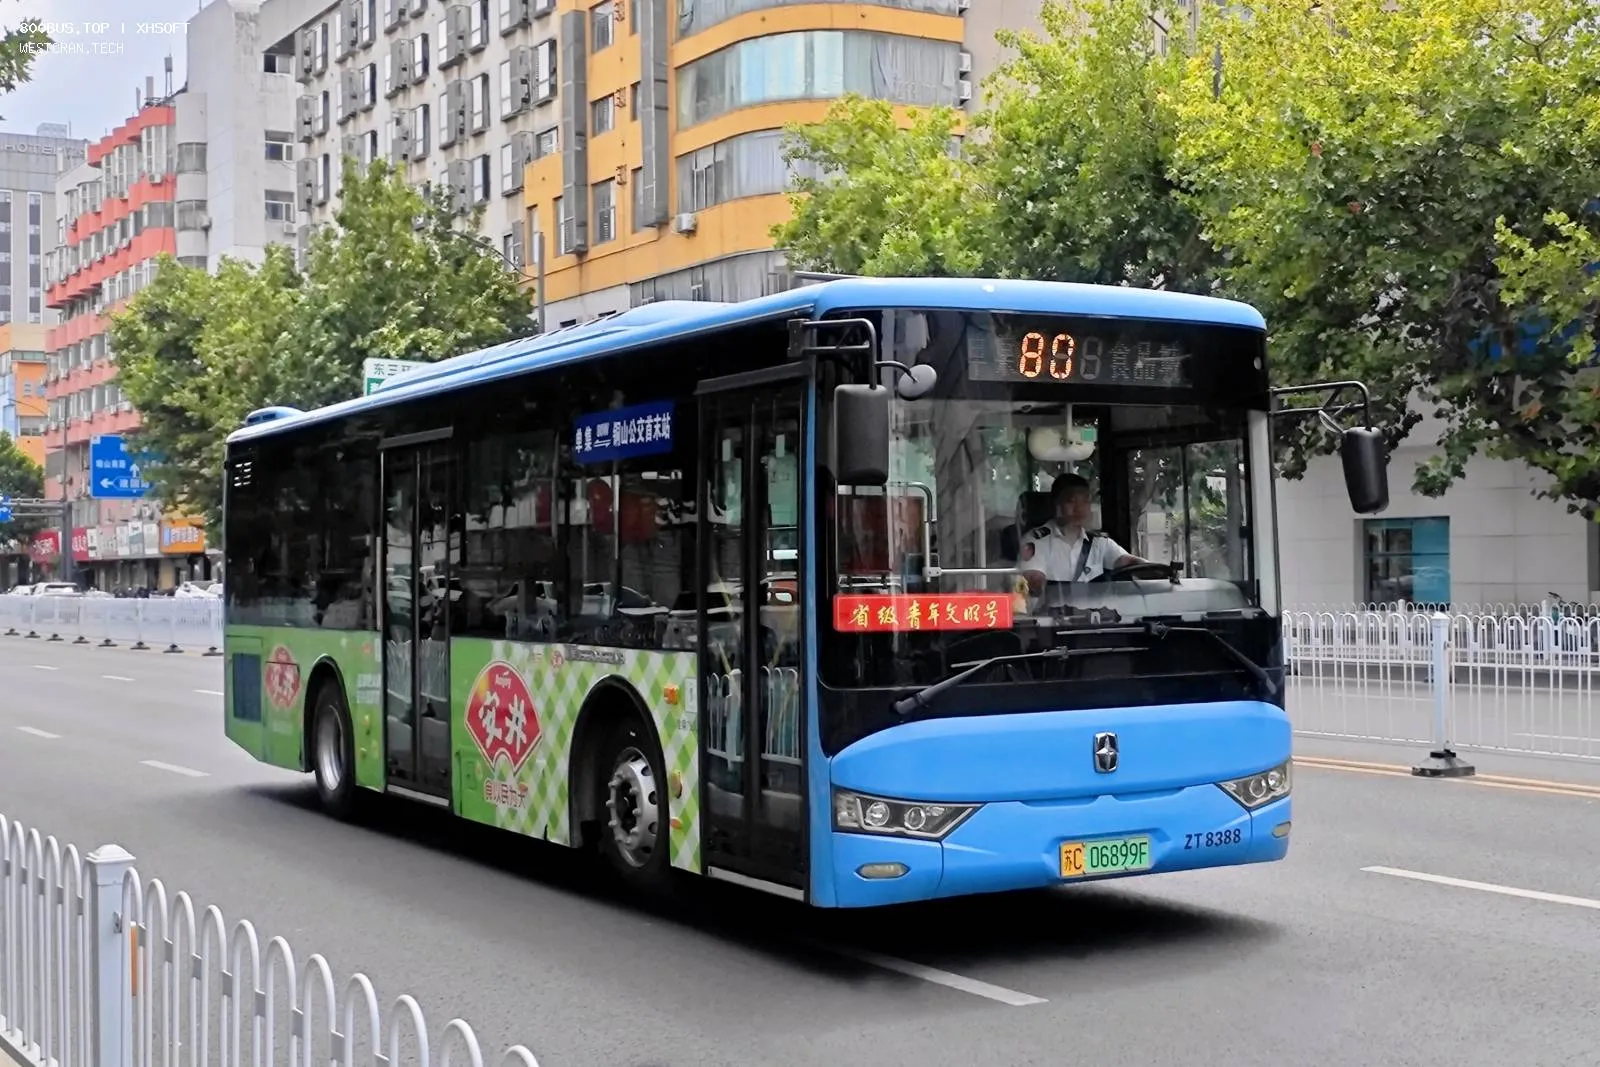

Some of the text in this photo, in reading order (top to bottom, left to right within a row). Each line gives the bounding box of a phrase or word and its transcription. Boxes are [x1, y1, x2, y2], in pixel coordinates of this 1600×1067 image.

[849, 600, 998, 629] 省级青年文明号
